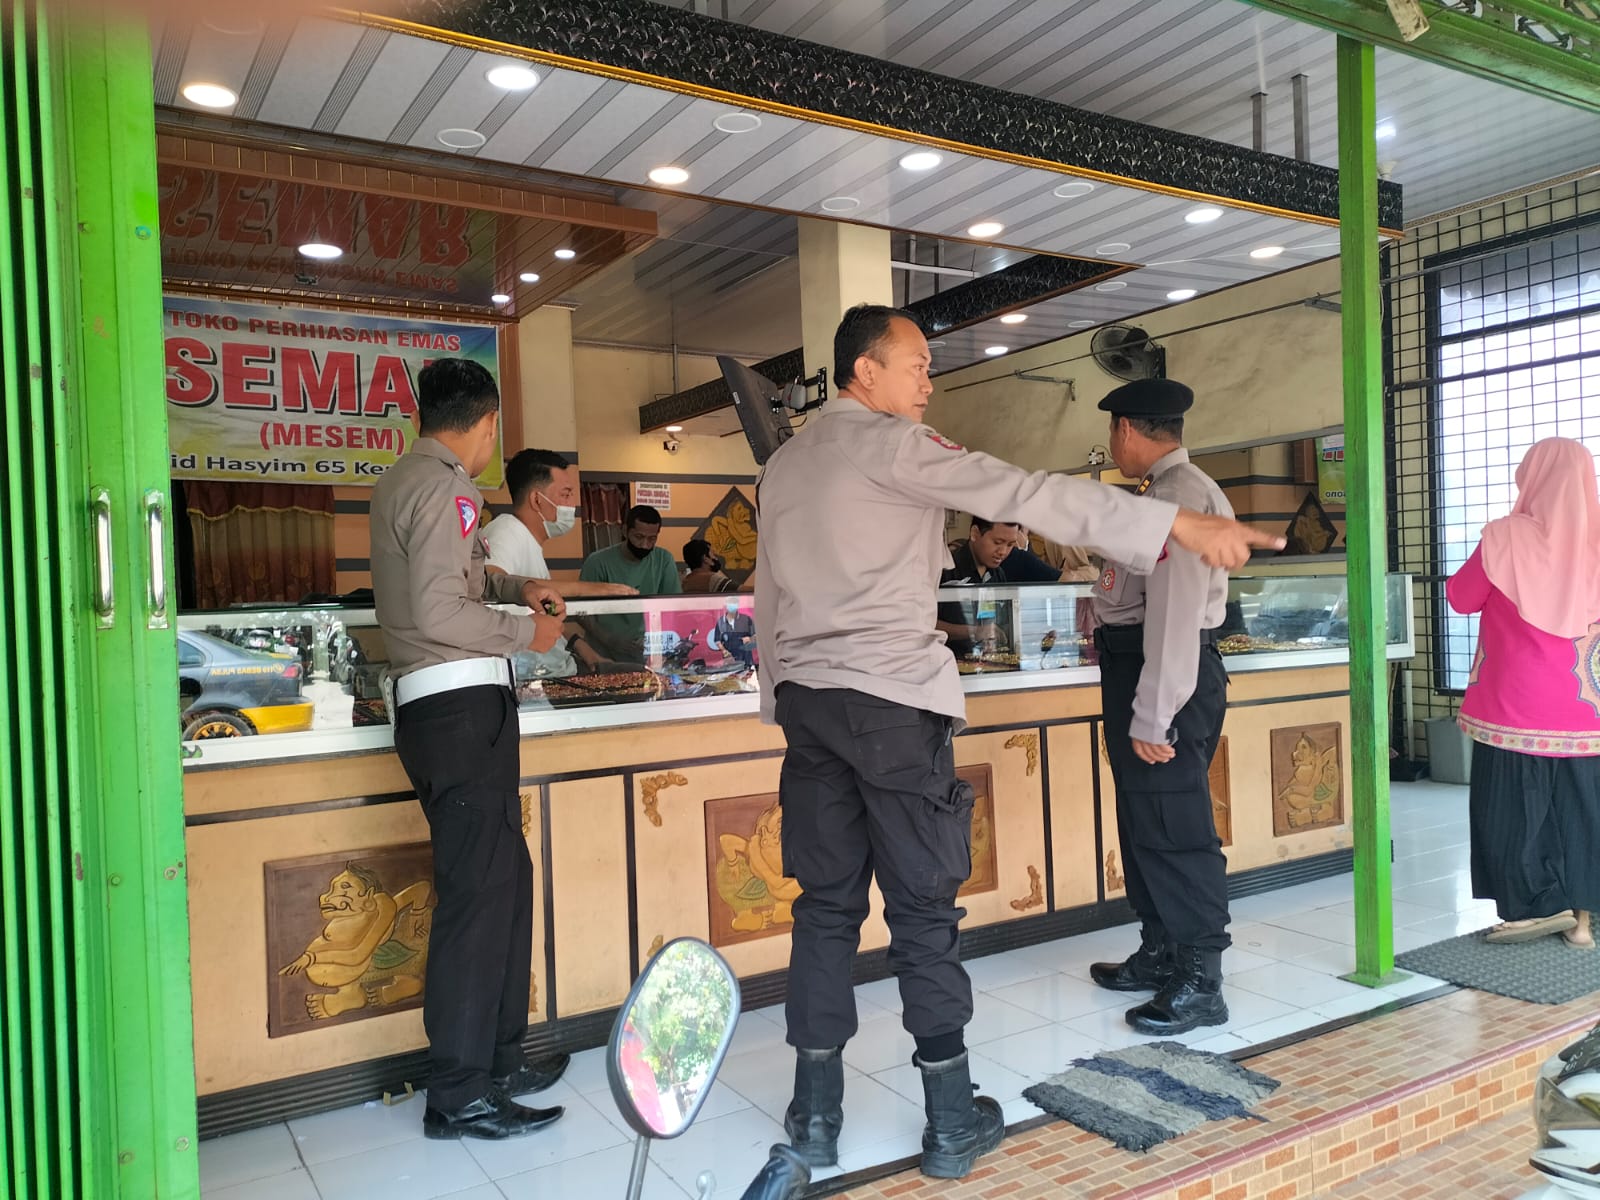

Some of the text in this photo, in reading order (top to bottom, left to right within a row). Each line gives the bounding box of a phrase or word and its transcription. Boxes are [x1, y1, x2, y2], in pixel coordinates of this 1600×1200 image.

[168, 310, 461, 351] TOKO PERHIASAN EMAS
[164, 337, 433, 418] SEMA
[259, 422, 405, 455] (MESEM)
[171, 454, 195, 469] id
[207, 456, 306, 474] Hasyim
[315, 460, 346, 474] 65
